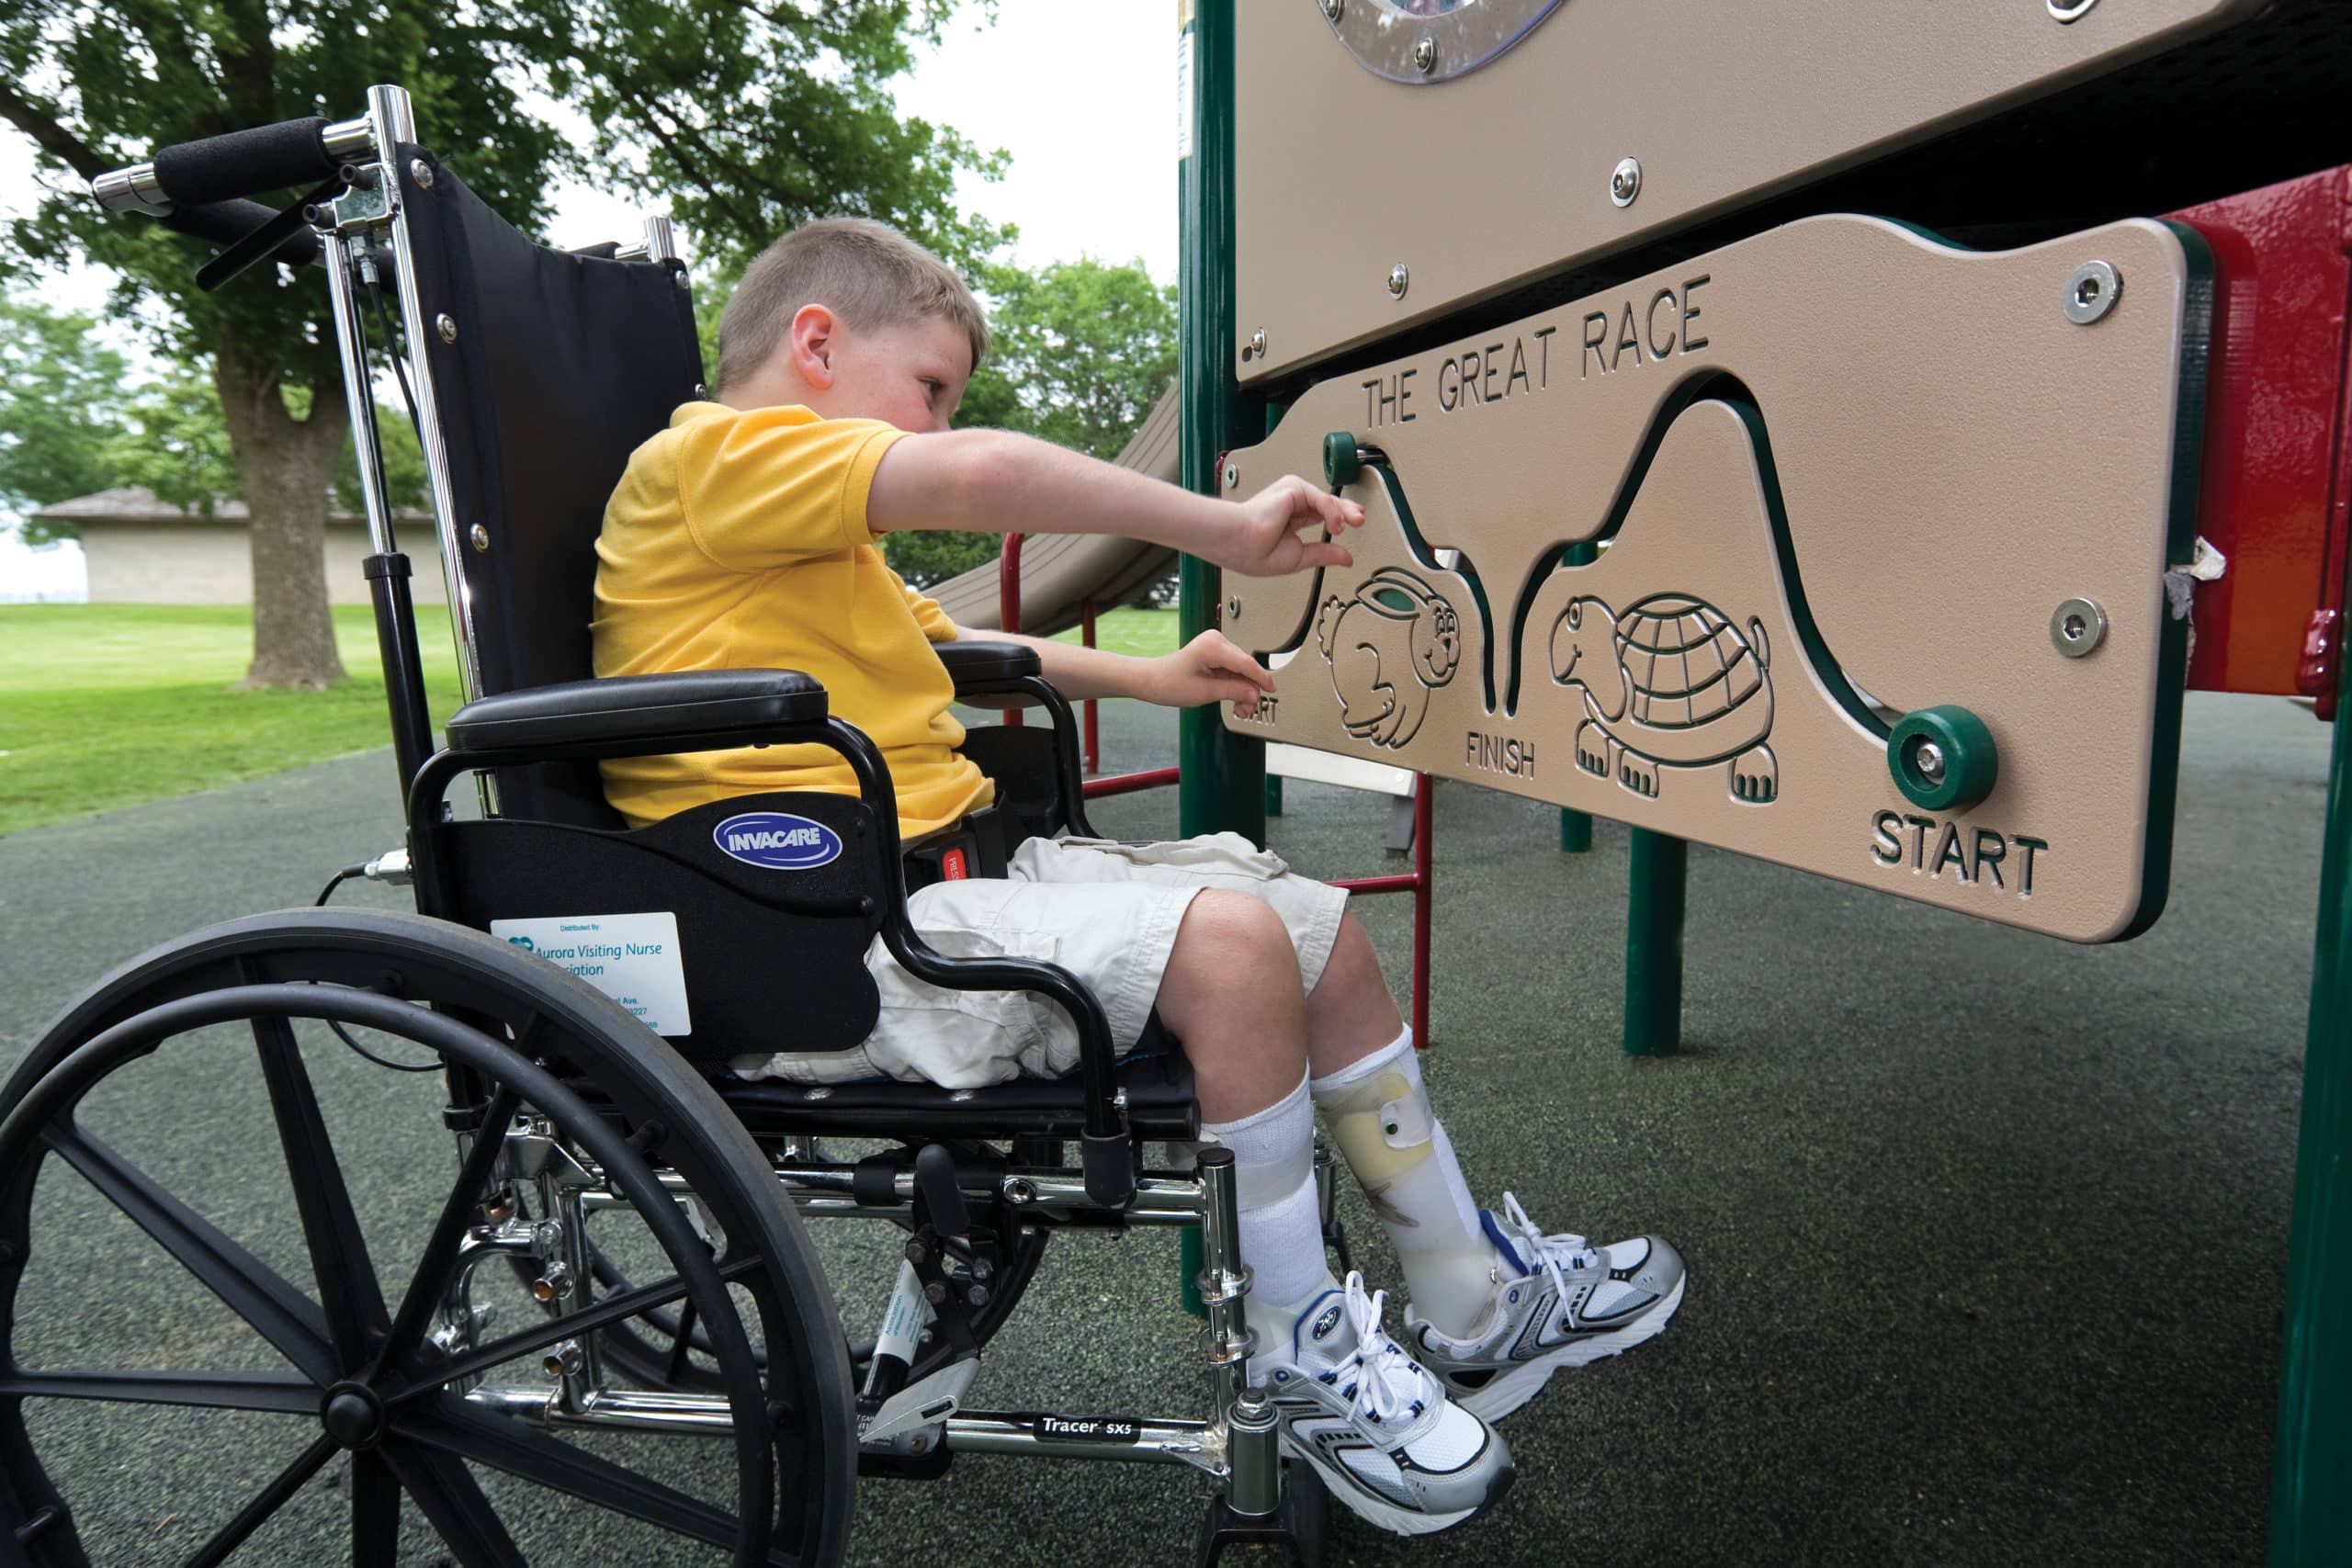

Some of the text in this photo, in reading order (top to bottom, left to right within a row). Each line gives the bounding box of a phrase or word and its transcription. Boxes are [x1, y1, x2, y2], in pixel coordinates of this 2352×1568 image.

[1362, 274, 1711, 431] THE GREAT RACE
[1465, 732, 1535, 781] FINISH
[728, 828, 821, 852] INVACARE
[1871, 809, 2049, 899] START
[536, 943, 662, 961] Aurora Visiting Nurse
[1043, 1417, 1099, 1433] Tracer
